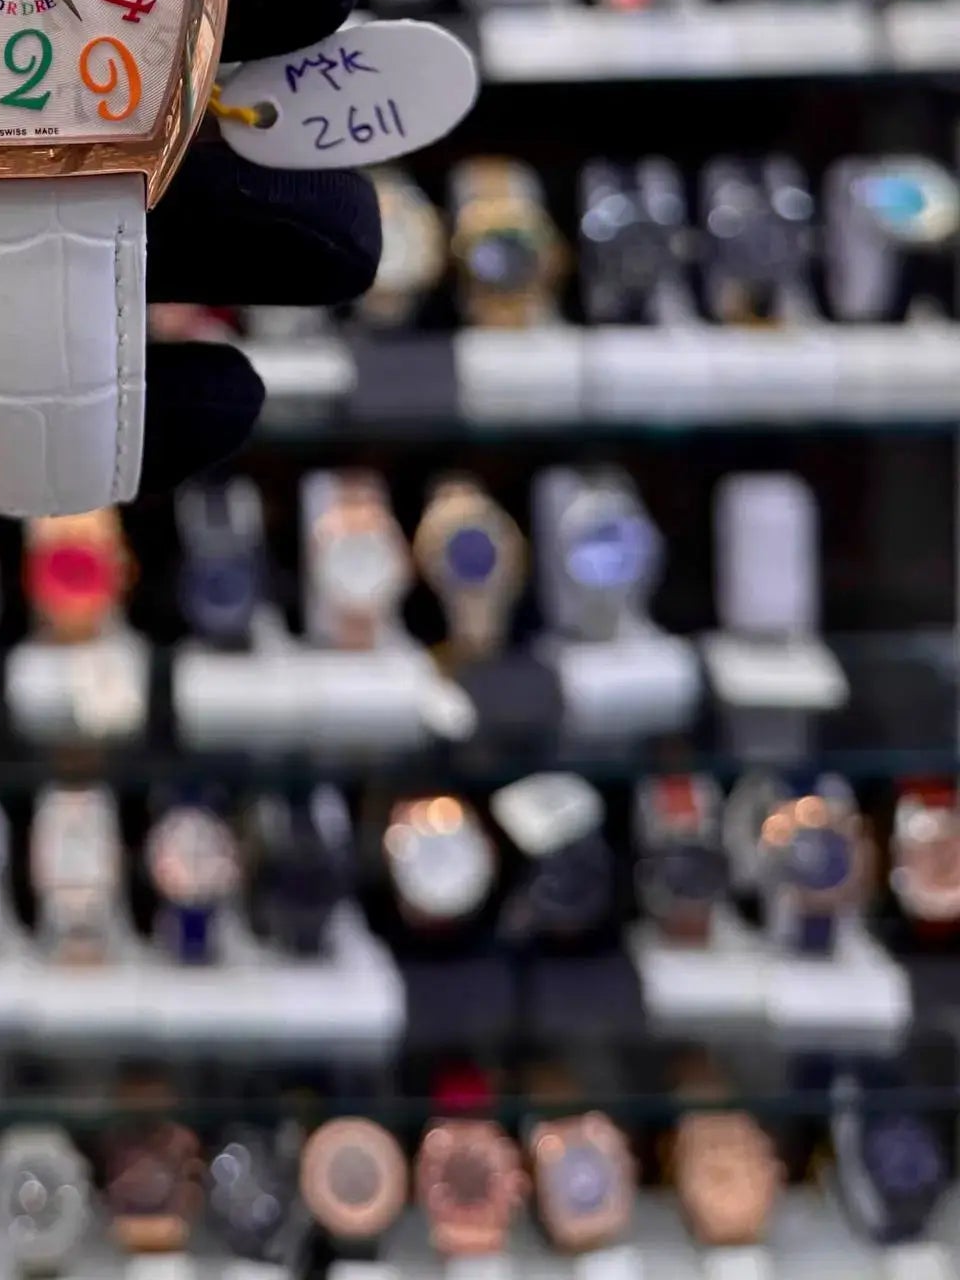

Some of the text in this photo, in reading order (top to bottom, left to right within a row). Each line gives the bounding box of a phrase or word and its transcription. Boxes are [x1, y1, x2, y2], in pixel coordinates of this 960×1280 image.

[80, 36, 141, 120] 9
[0, 127, 59, 136] SWISS MADE
[302, 98, 406, 150] 2611
